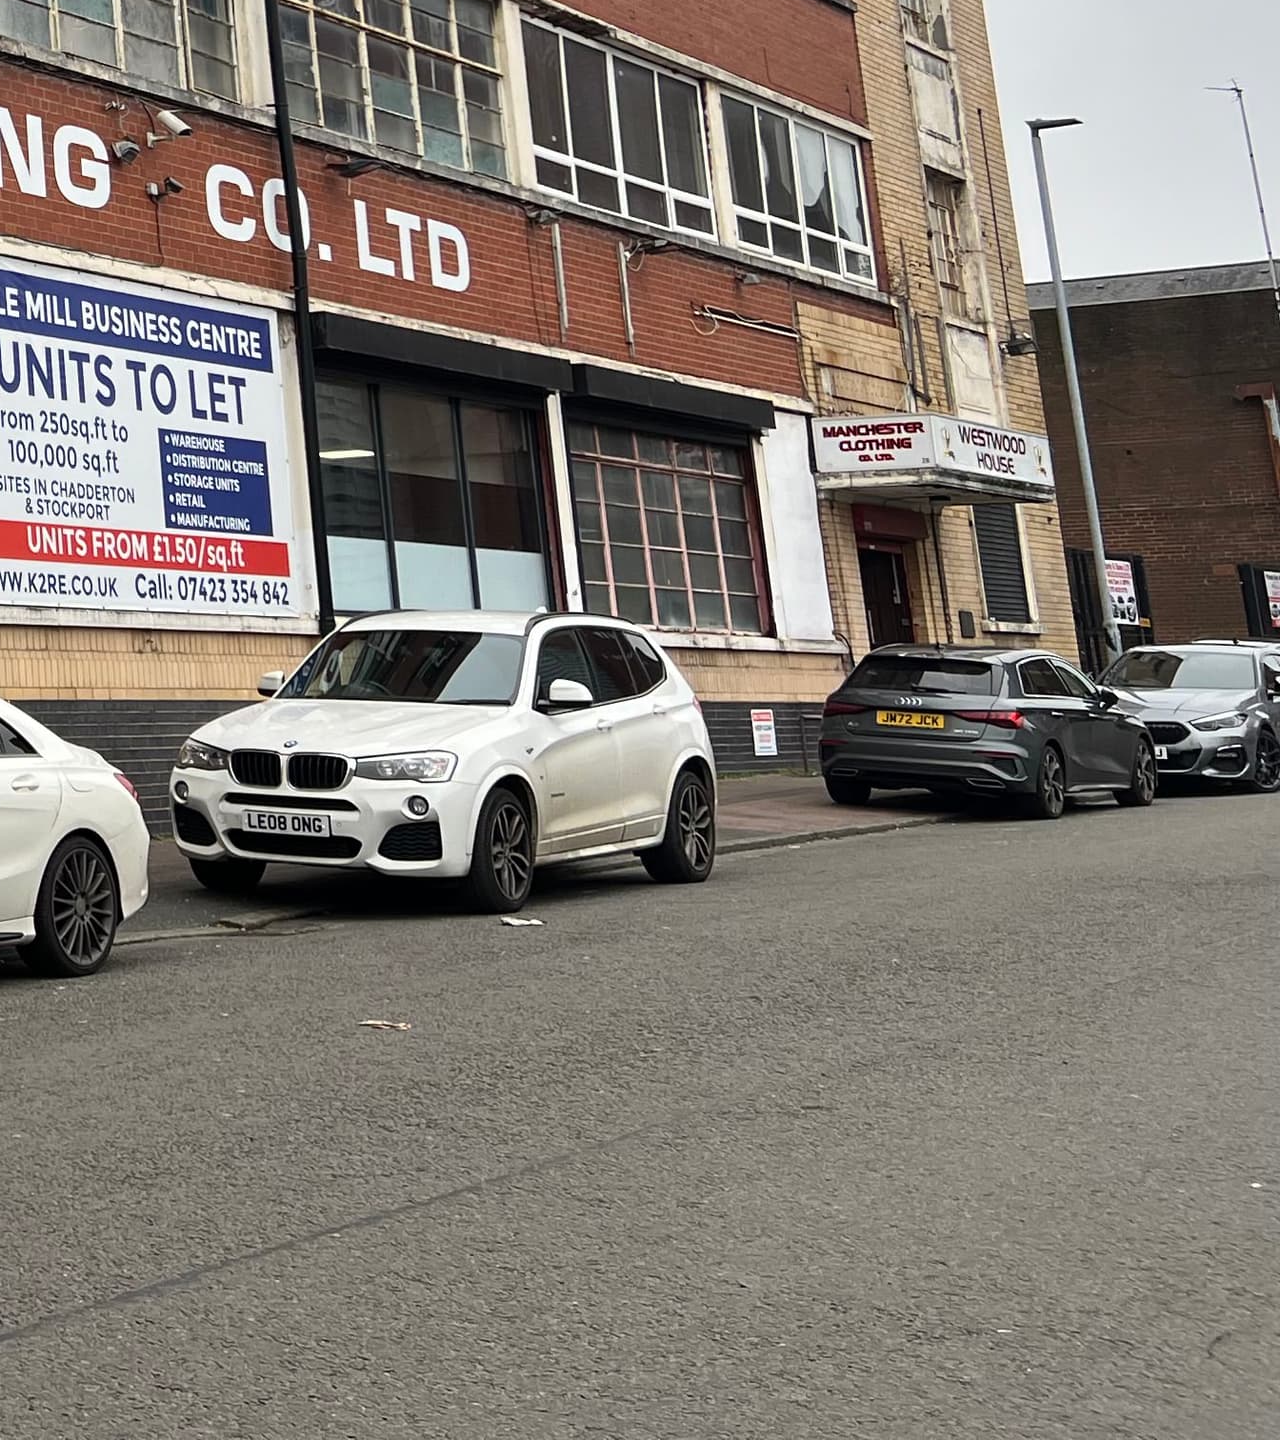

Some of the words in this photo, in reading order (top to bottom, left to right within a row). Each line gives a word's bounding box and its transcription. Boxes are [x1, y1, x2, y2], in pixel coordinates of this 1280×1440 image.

[205, 163, 333, 262] CO.
[353, 198, 471, 293] LTD
[24, 290, 77, 329] MILL
[82, 301, 182, 346] BUSINESS
[185, 320, 262, 359] CENTRE
[126, 359, 177, 415] TO
[188, 369, 247, 425] LET
[40, 410, 107, 444] 250sq.ft
[111, 419, 128, 443] to
[822, 421, 925, 439] MANCHESTER
[170, 433, 225, 453] WAREHOUSE
[839, 437, 913, 452] CLOTHING
[957, 424, 1027, 455] WESTWOOD
[8, 439, 78, 469] 100,000
[82, 449, 120, 478] sq.ft
[172, 453, 231, 472] DISTRIBUTION
[232, 460, 265, 476] CENTRE
[977, 451, 1016, 476] HOUSE
[34, 478, 47, 496] IN
[50, 480, 135, 504] CHADDERTON
[174, 473, 214, 490] STORAGE
[214, 478, 240, 492] UNITS
[25, 497, 34, 514] &
[36, 498, 111, 521] STOCKPORT
[175, 492, 206, 508] RETAIL
[176, 512, 251, 531] MANUFACTURING
[27, 525, 88, 557] UNITS
[91, 530, 149, 560] FROM
[153, 535, 246, 572] £1.50/sq.ft
[135, 573, 173, 600] Call:
[178, 576, 227, 603] 07423
[231, 579, 258, 604] 354
[262, 581, 290, 605] 842
[916, 715, 940, 727] JCK
[247, 812, 287, 831] LE08
